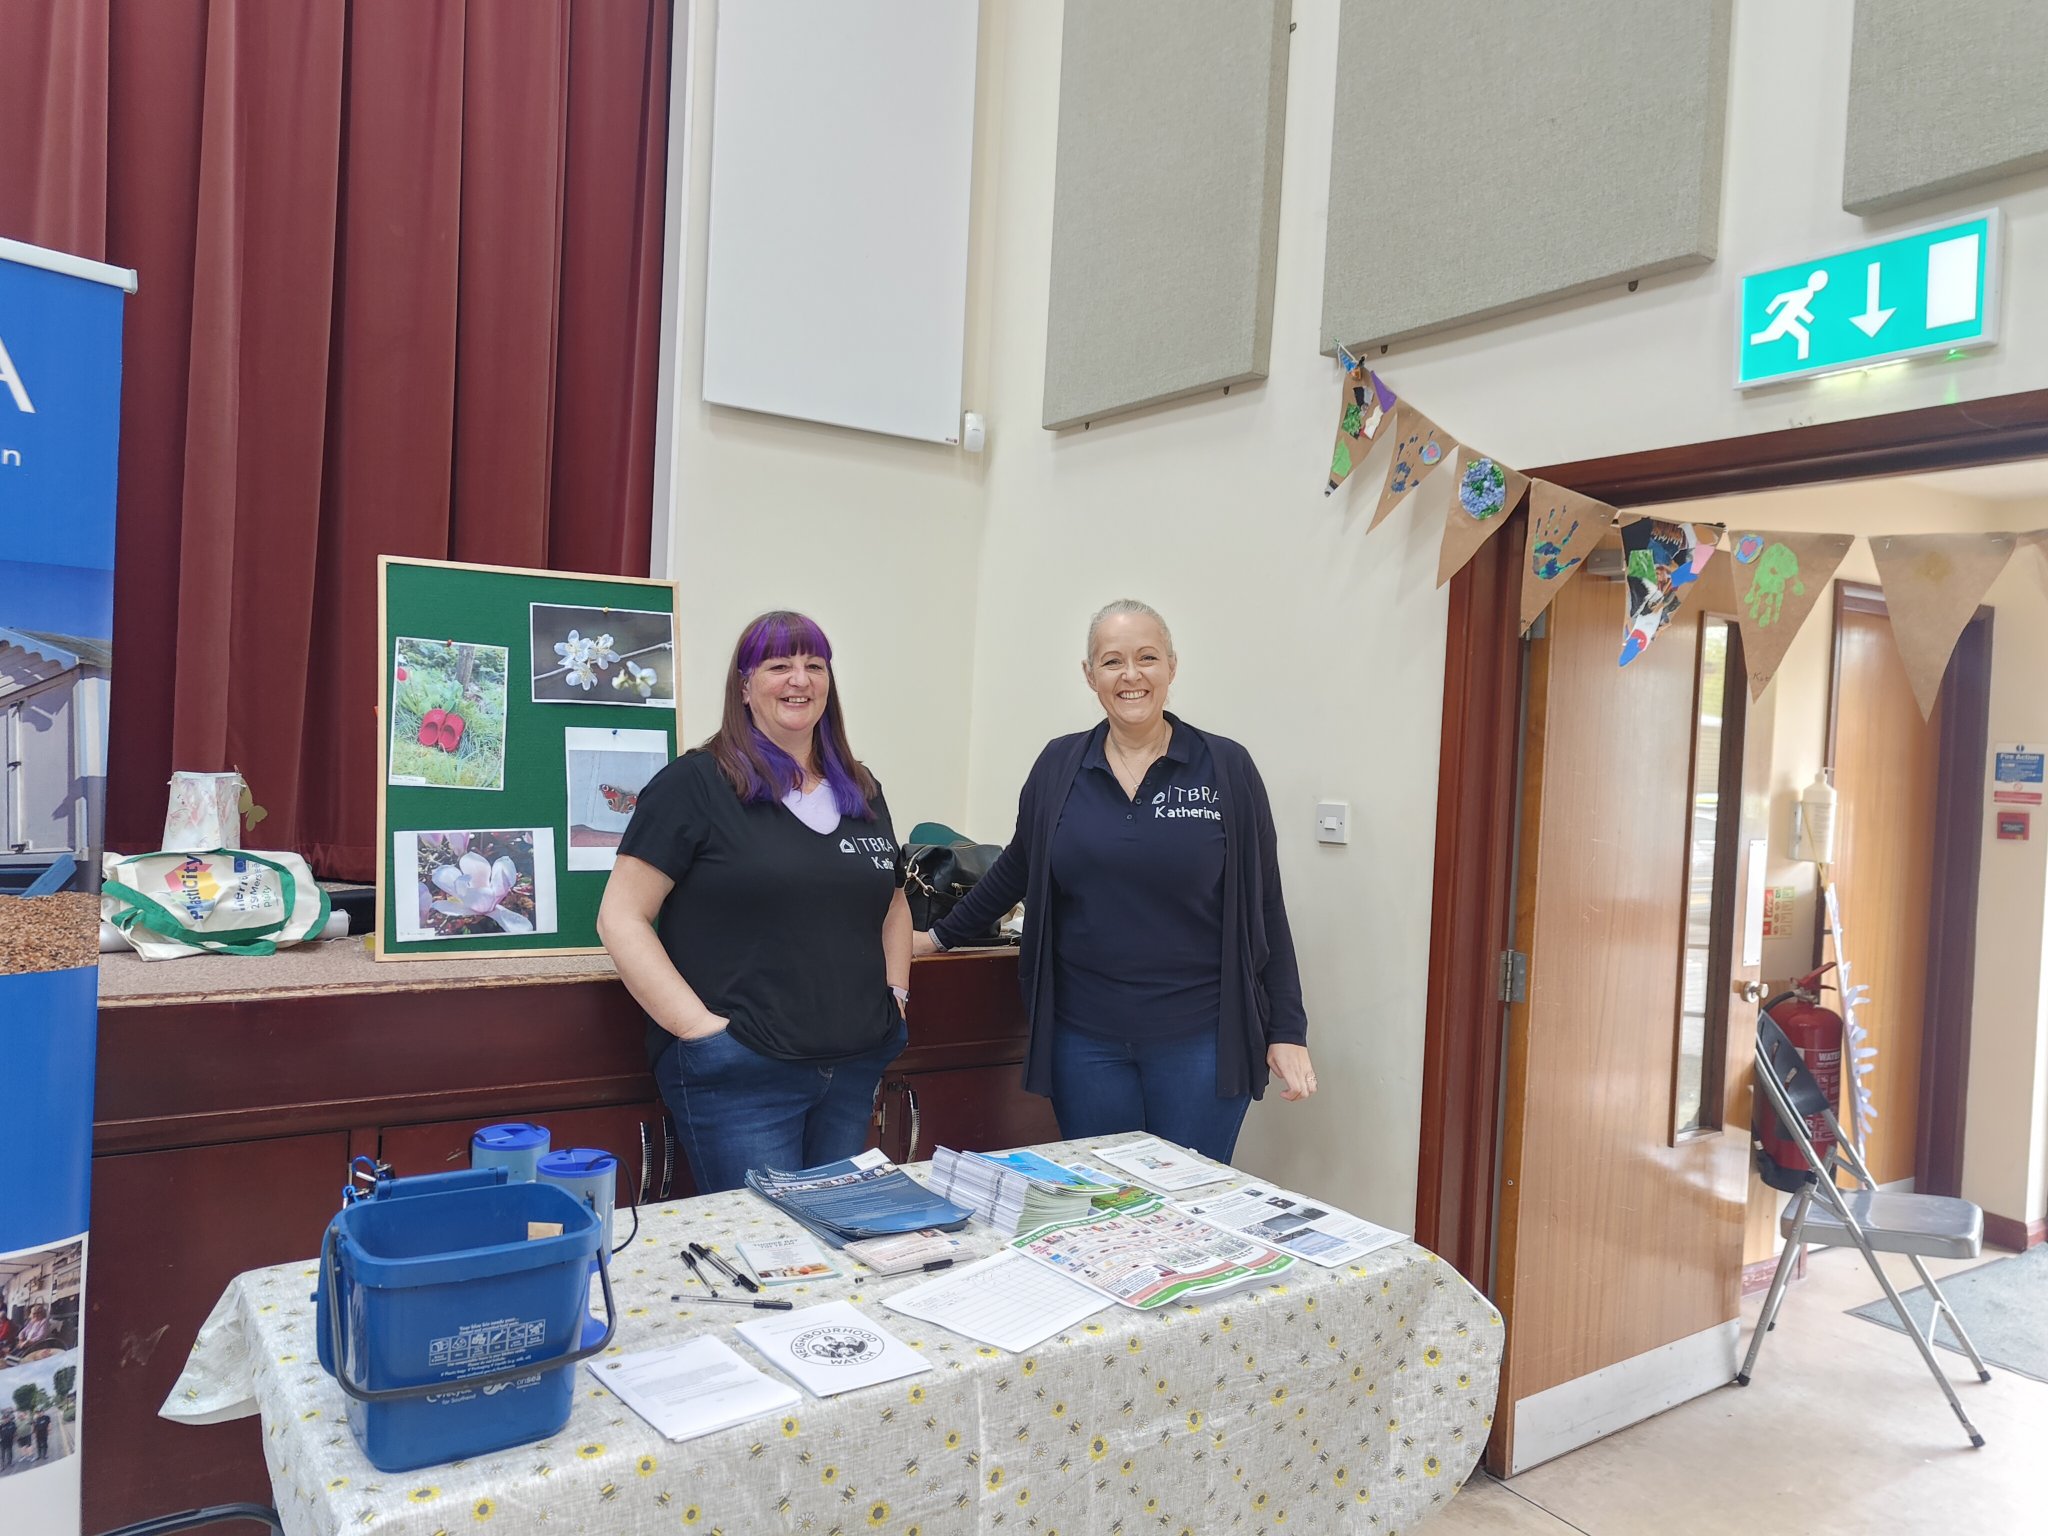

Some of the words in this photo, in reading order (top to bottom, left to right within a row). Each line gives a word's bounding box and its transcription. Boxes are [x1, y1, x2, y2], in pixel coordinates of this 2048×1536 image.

[2016, 753, 2040, 761] Action
[1155, 805, 1221, 821] Katherine
[857, 836, 895, 853] TBRA
[794, 1326, 878, 1359] NEIGHBOURHOOD
[830, 1350, 877, 1365] WATCH
